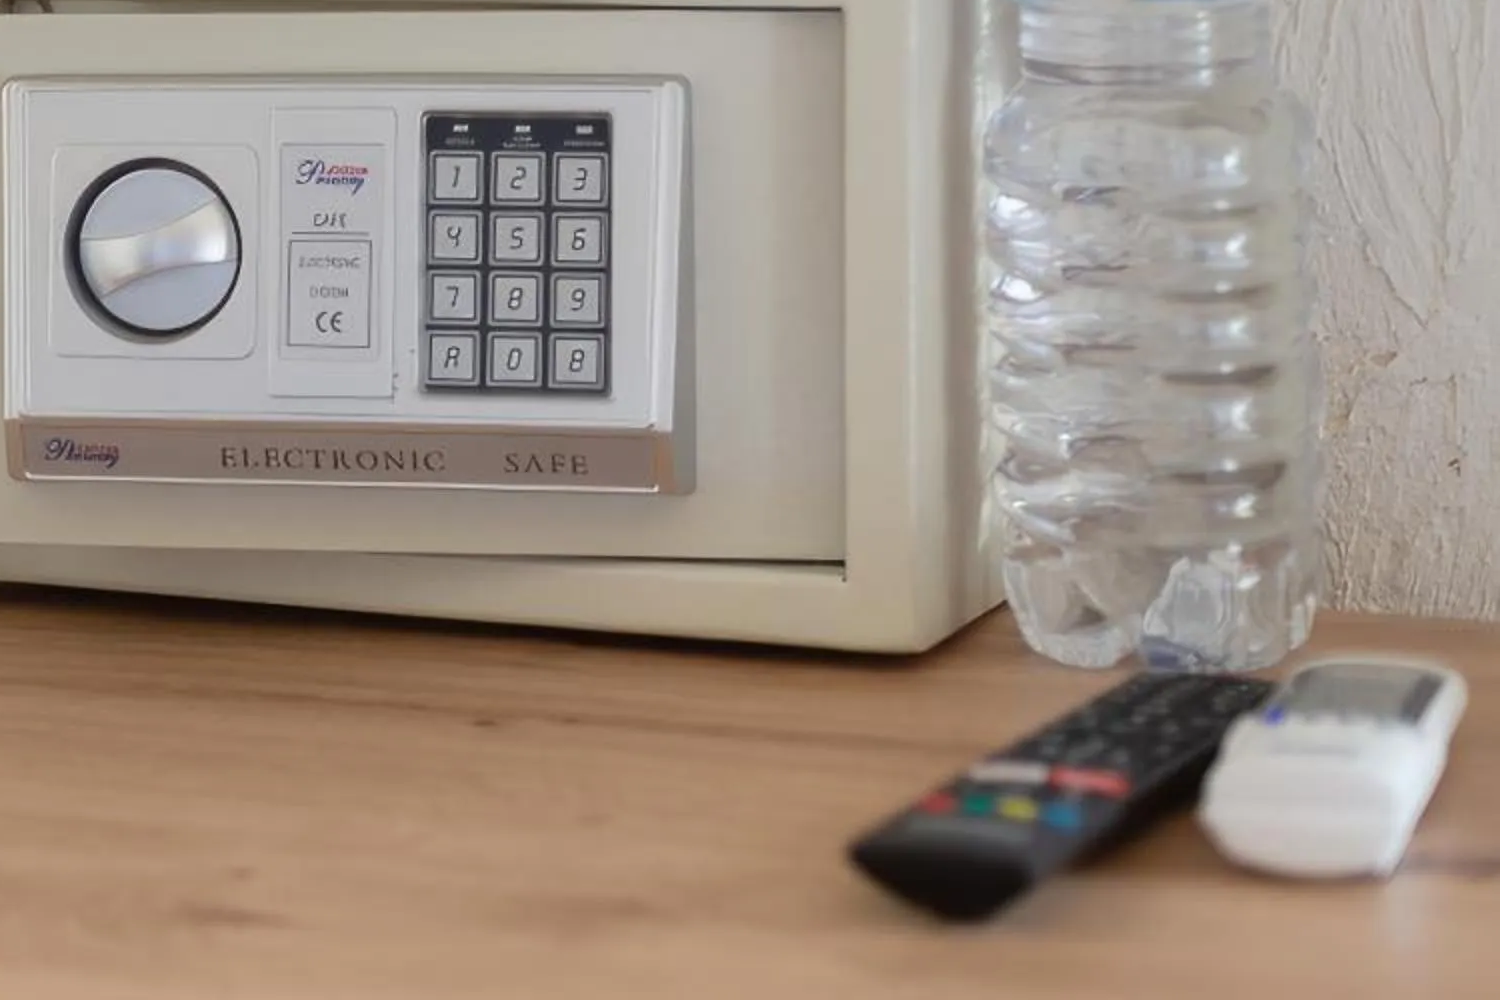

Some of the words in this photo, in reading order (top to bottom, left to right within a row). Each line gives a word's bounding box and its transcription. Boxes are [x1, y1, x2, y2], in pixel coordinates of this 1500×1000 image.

[511, 165, 527, 190] 2
[572, 167, 588, 191] 3
[446, 226, 461, 247] 4
[509, 226, 524, 249] 5
[571, 228, 587, 250] 6
[446, 285, 460, 307] 7
[507, 287, 523, 310] 8
[570, 288, 586, 311] 9
[220, 446, 447, 472] ELECTRONIC
[503, 452, 590, 475] SAFE
